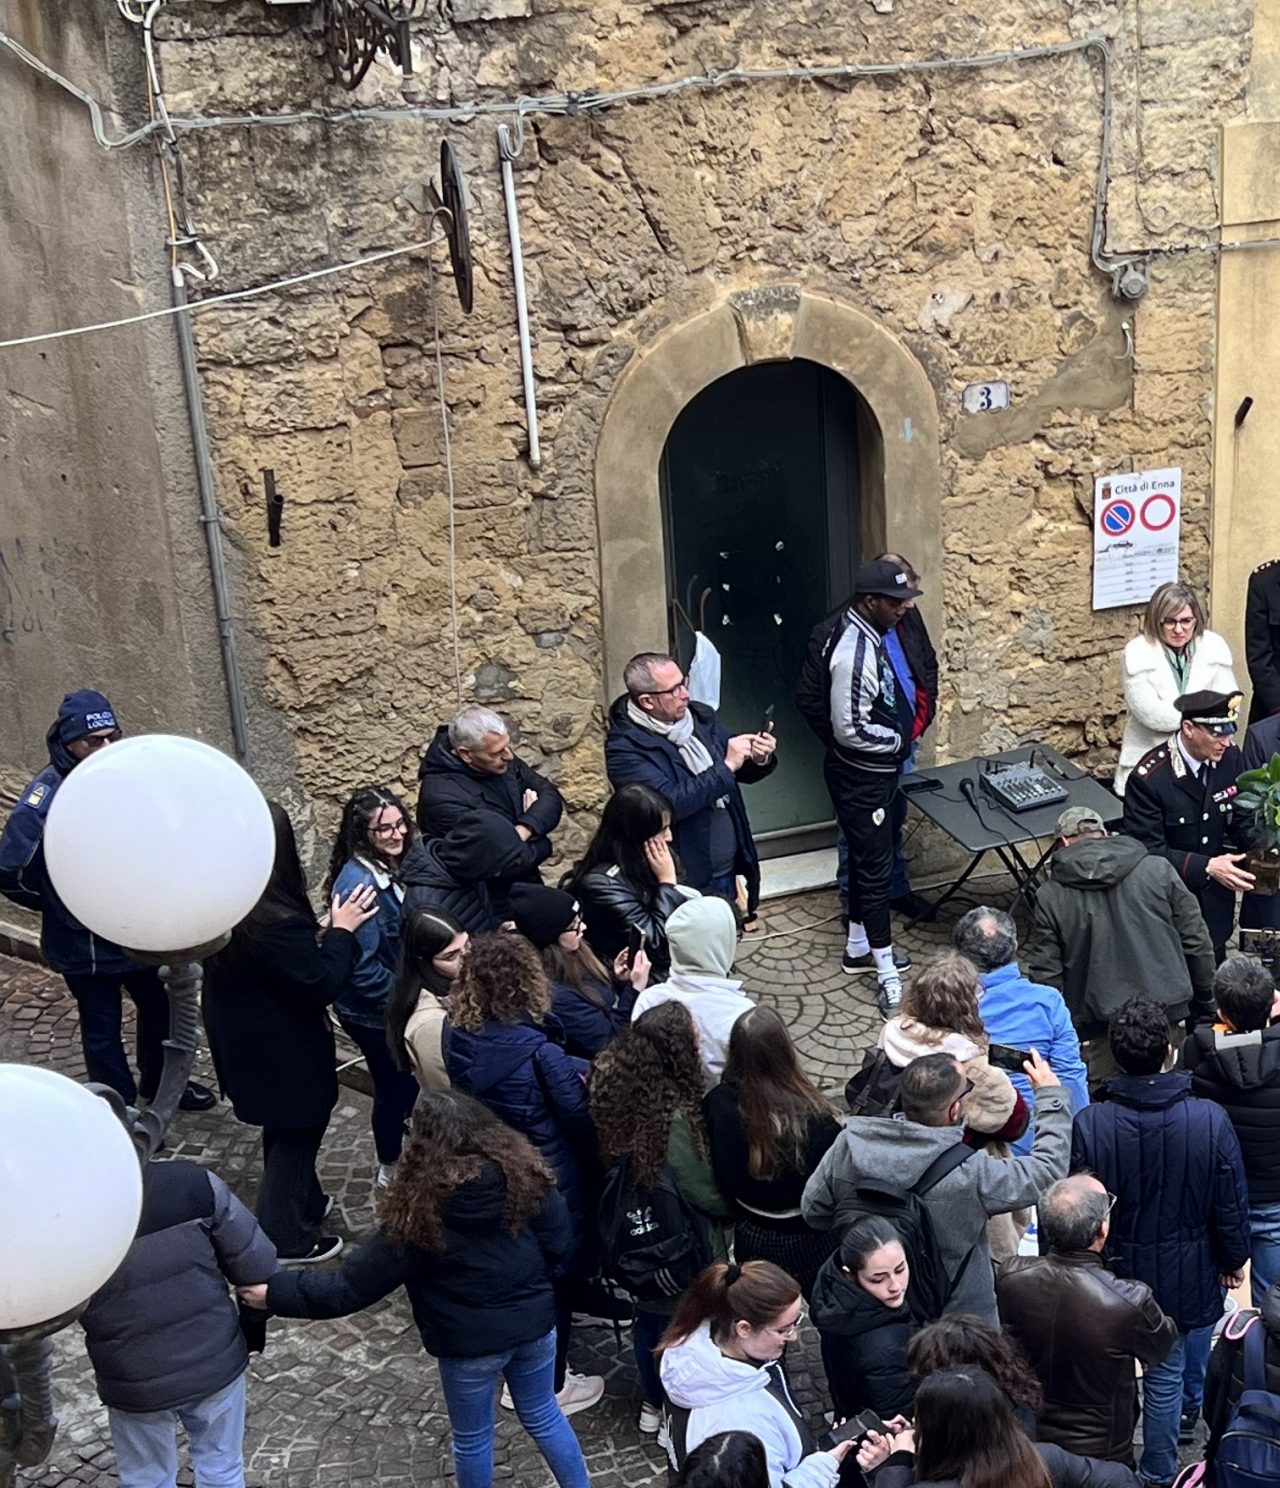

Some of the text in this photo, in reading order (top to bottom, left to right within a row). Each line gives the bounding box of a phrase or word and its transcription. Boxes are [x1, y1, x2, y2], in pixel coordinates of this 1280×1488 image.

[979, 386, 992, 410] 3
[1115, 480, 1175, 495] Città di Enna
